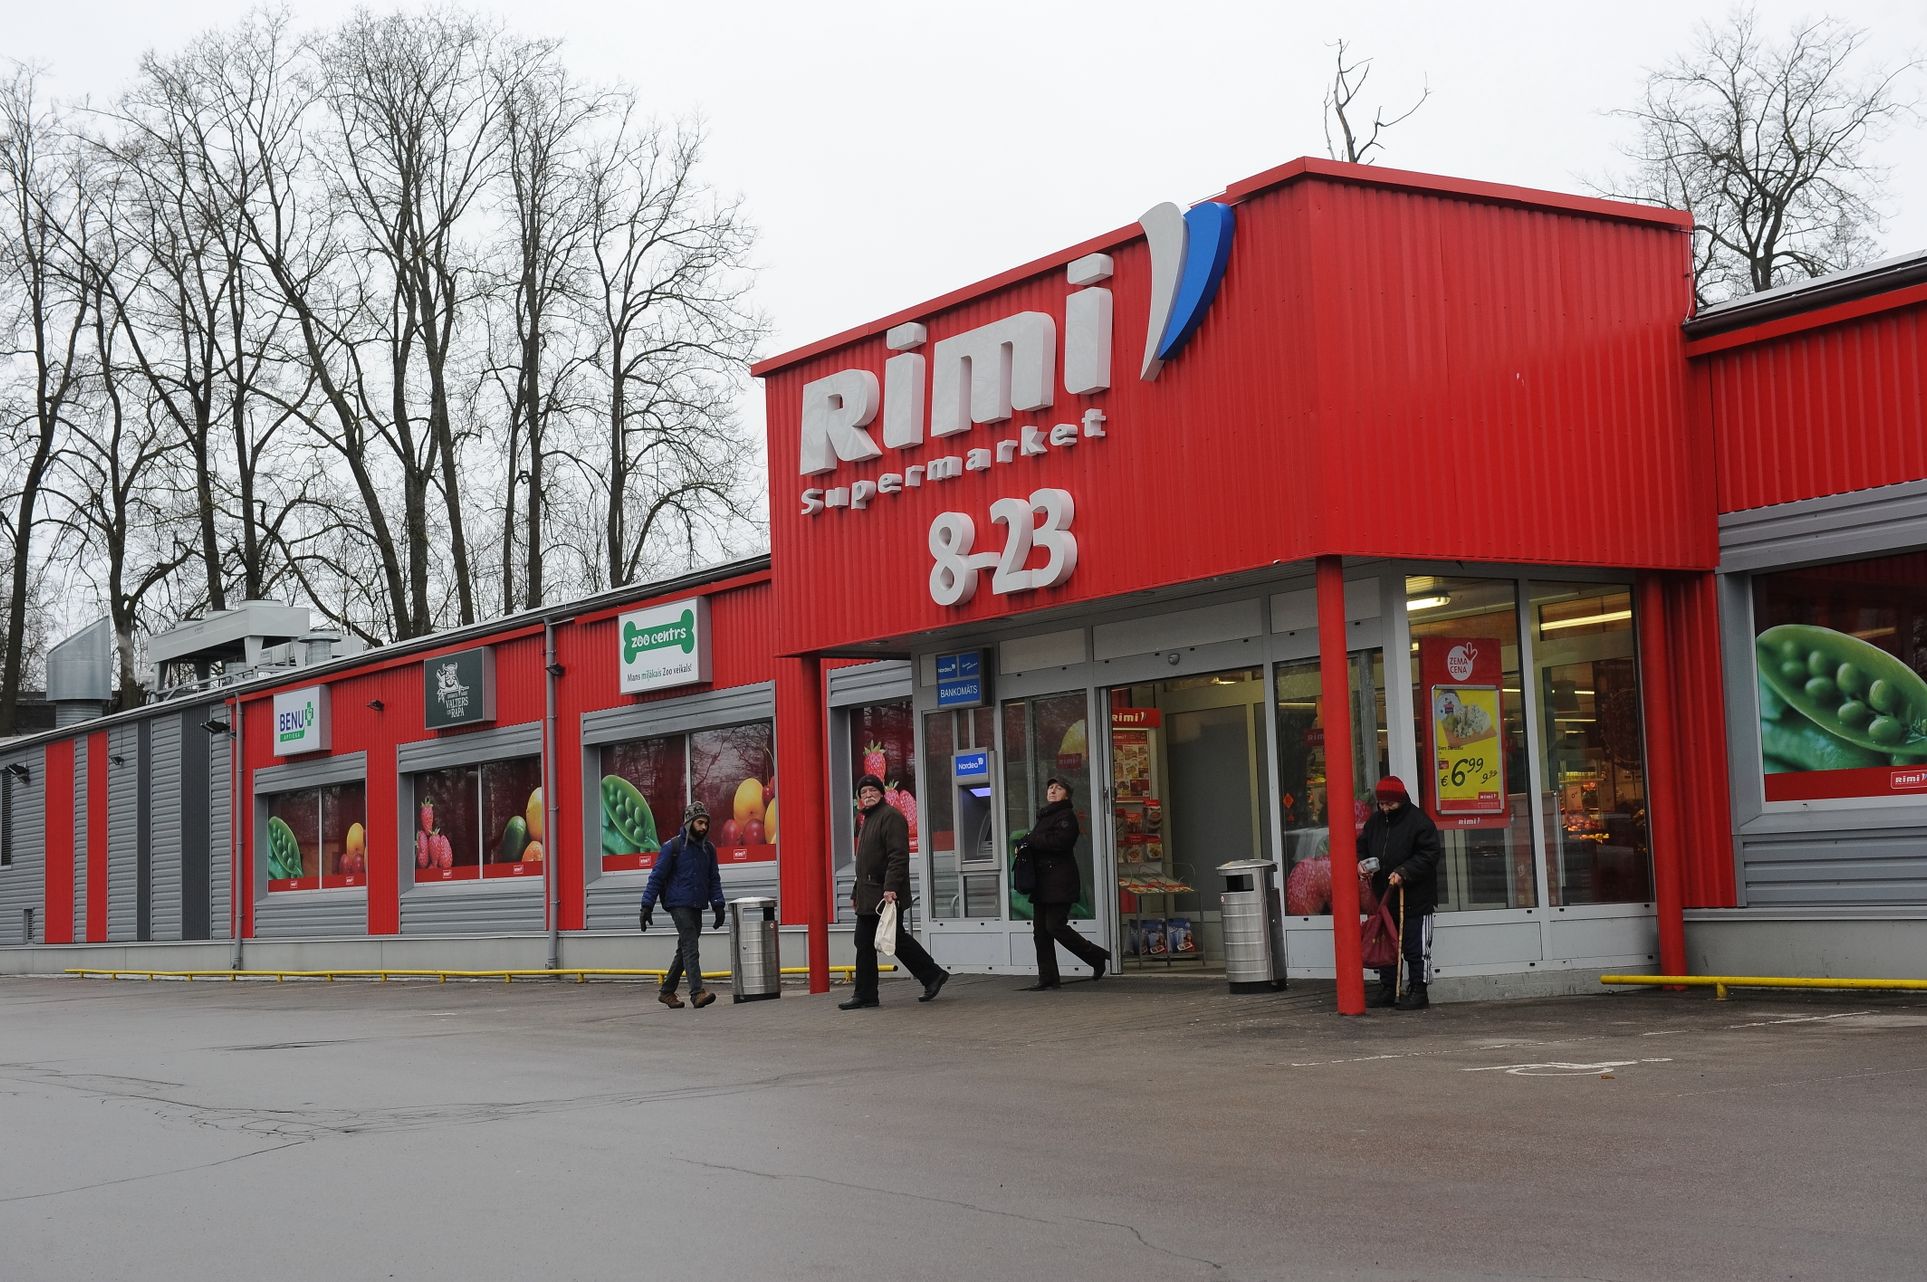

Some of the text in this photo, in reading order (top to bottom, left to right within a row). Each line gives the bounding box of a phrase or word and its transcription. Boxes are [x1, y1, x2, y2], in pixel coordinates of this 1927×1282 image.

[800, 252, 1114, 476] Rimi
[929, 488, 1078, 606] 8-23
[651, 627, 687, 644] centrs
[1449, 657, 1468, 665] ZEMA
[662, 667, 673, 677] Zoo
[1450, 665, 1467, 674] CENA
[941, 684, 978, 698] BANKOMĀTS
[446, 696, 469, 709] VALTERS
[280, 710, 304, 732] BENU
[958, 762, 978, 770] Nordea
